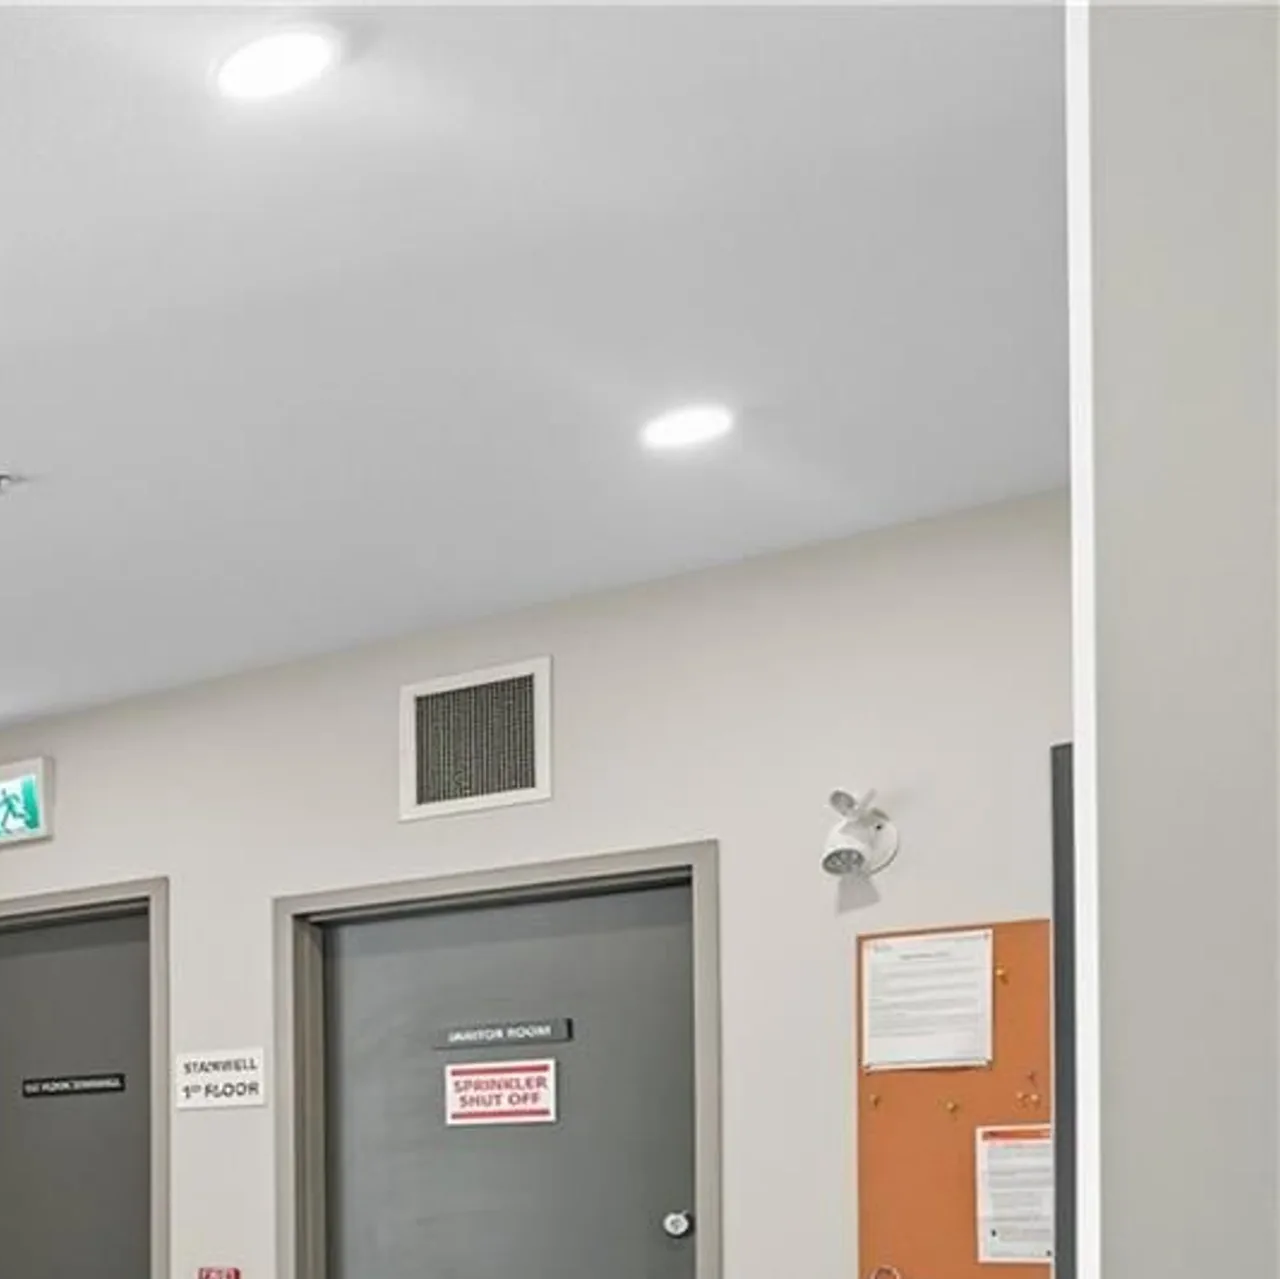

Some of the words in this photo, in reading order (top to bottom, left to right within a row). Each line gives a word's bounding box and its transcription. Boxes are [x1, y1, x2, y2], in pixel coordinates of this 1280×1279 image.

[507, 1025, 552, 1038] ROOM
[205, 1082, 260, 1098] FLOOR
[454, 1075, 548, 1093] SPRINKLER
[459, 1094, 502, 1108] SHUT
[507, 1092, 541, 1106] OFF
